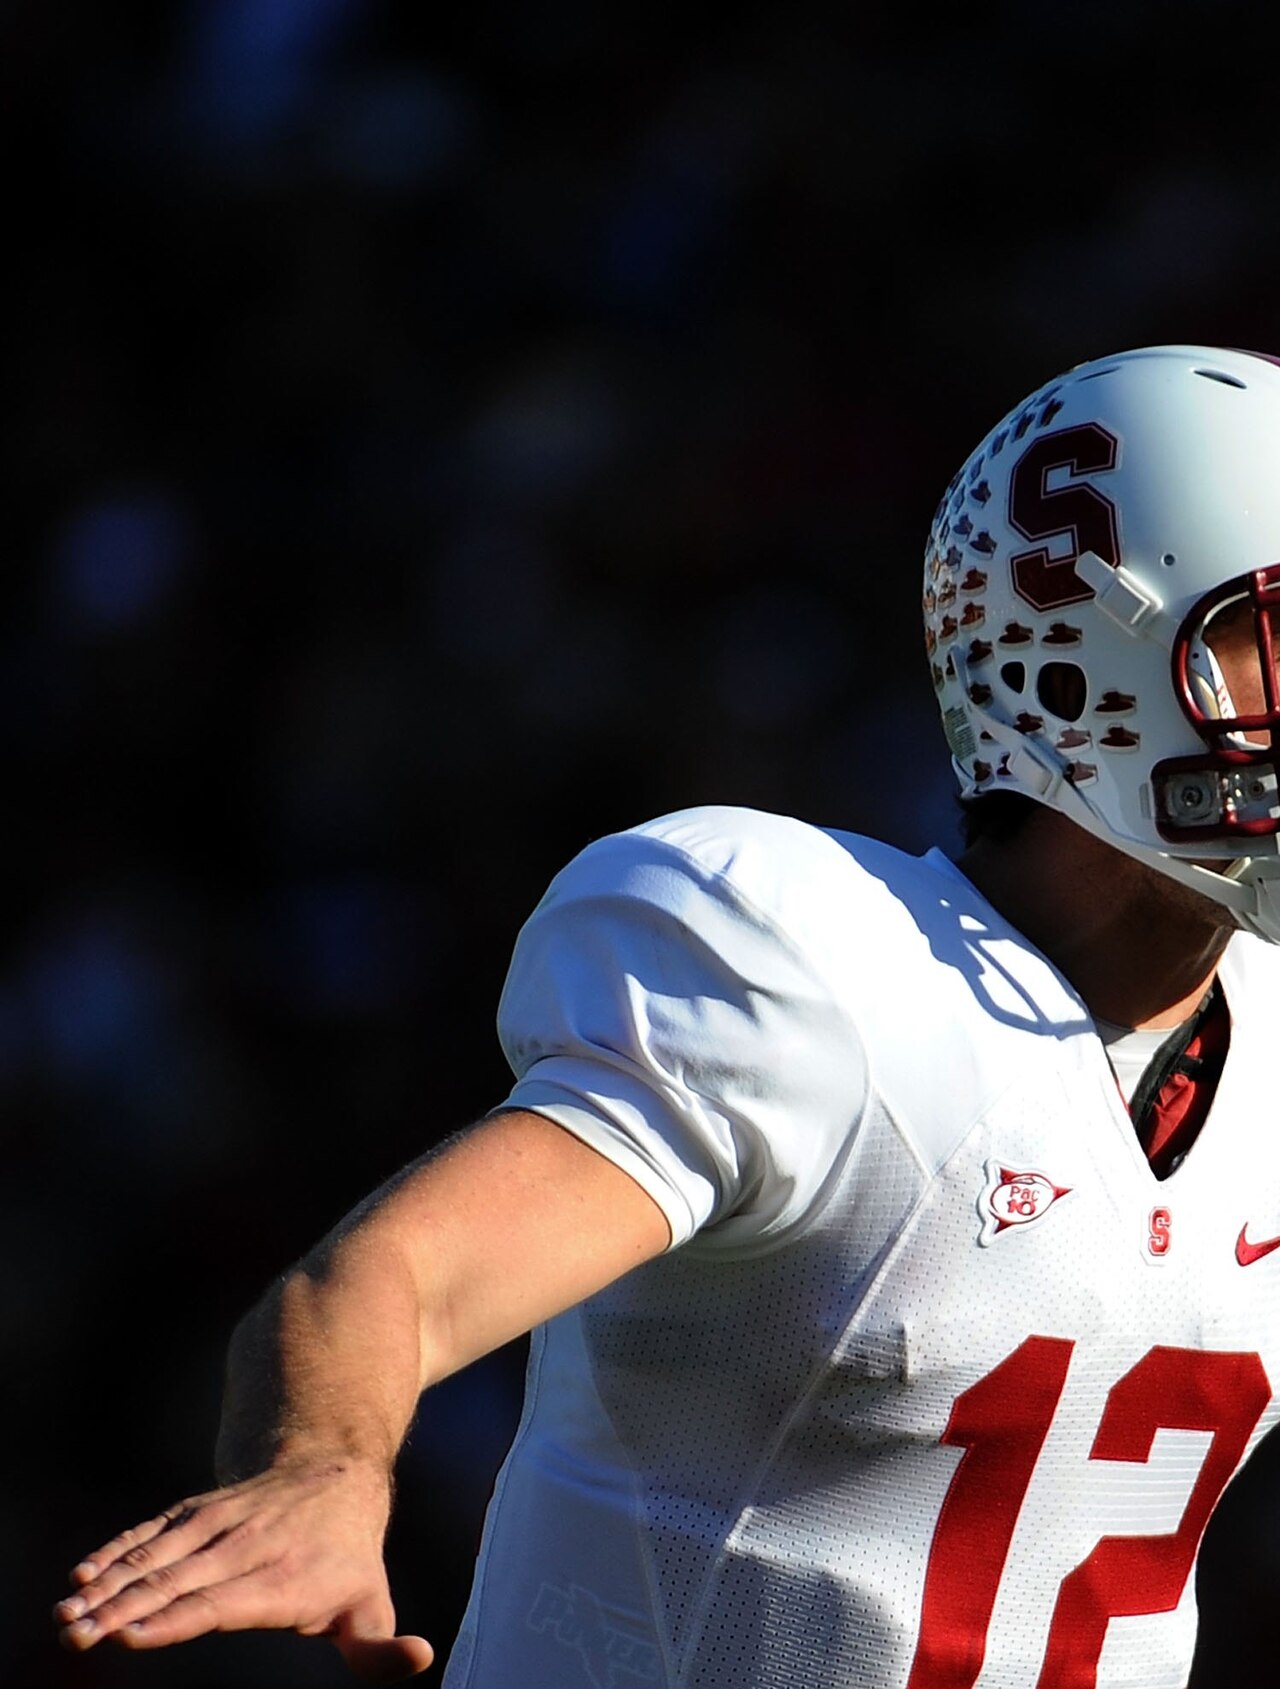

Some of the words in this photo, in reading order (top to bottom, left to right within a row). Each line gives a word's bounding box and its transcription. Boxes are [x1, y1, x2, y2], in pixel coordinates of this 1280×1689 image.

[1007, 421, 1123, 613] S
[1007, 1198, 1036, 1216] 10
[1148, 1206, 1172, 1257] S
[906, 1334, 1273, 1689] 12
